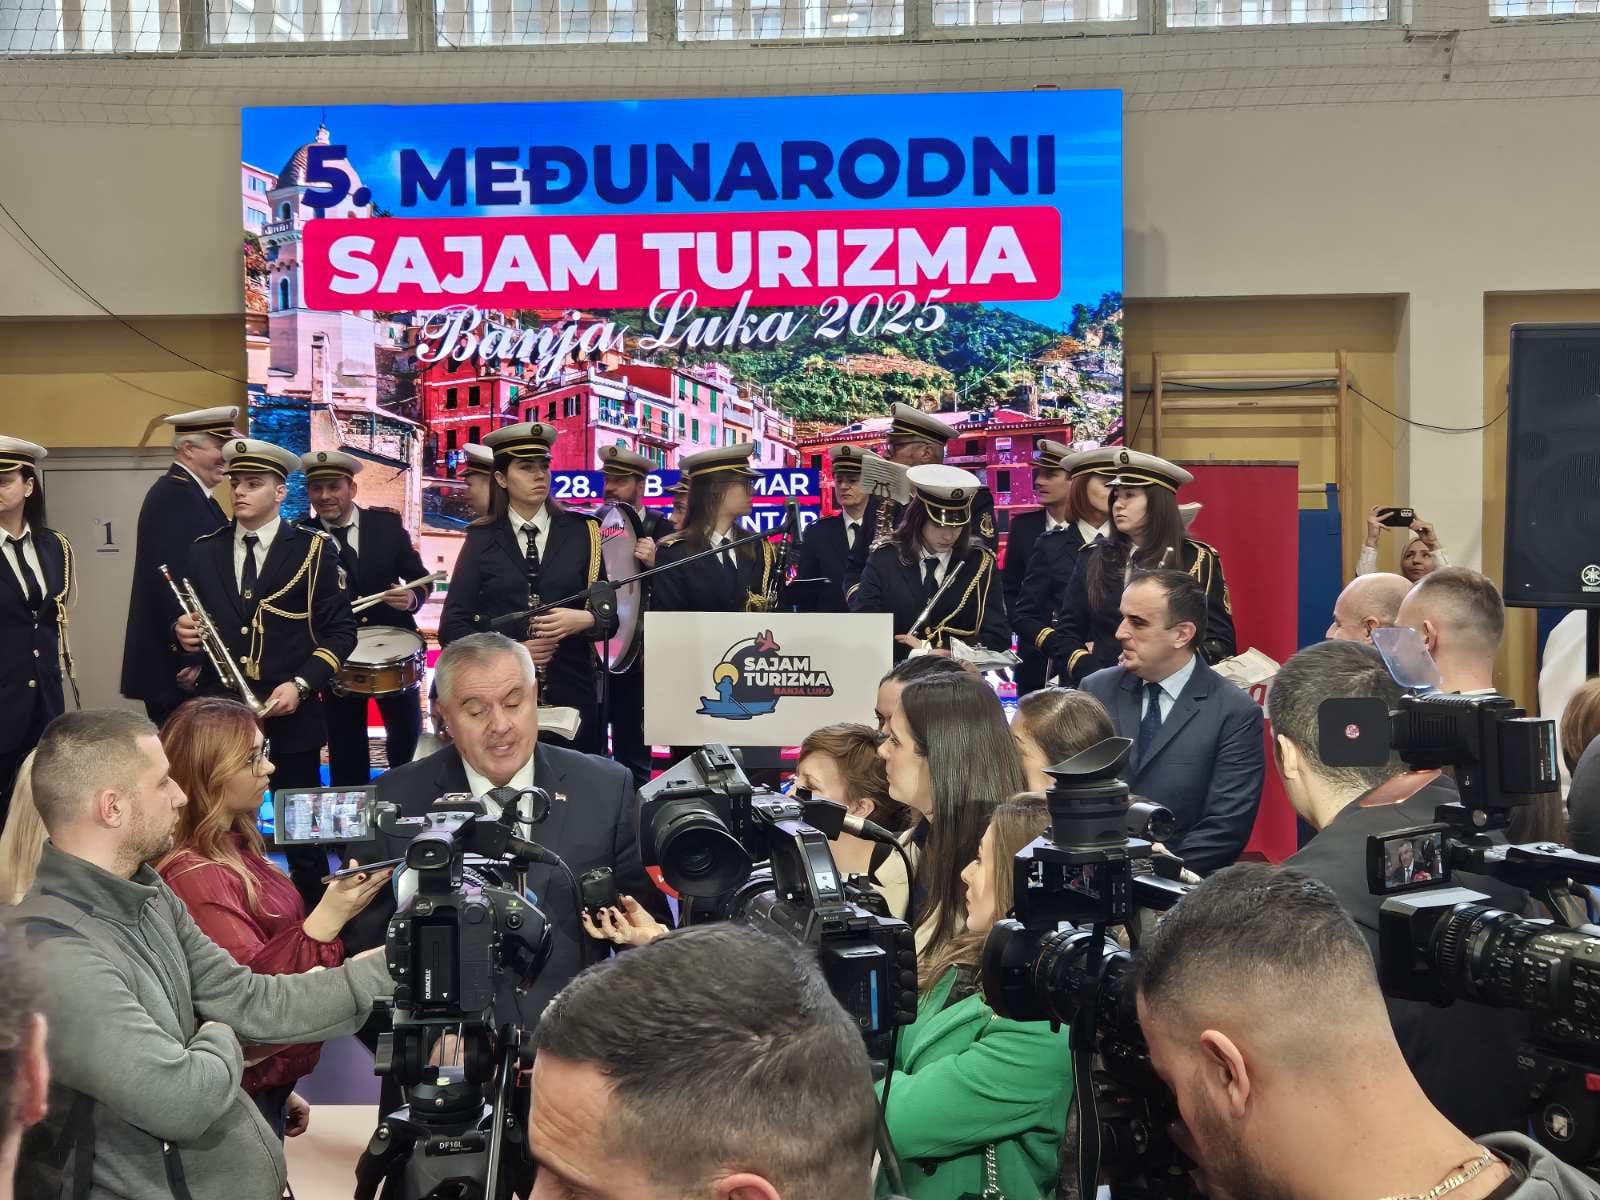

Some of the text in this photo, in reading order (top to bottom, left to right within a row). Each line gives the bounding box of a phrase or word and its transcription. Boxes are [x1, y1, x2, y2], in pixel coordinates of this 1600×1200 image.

[301, 134, 1056, 209] 5. MEĐUNARODNI
[328, 225, 1037, 295] SAJAM TURIZMA
[415, 288, 951, 384] Banja Luka 2025
[554, 475, 598, 498] 28.
[103, 521, 114, 545] 1
[744, 656, 809, 671] SAJAM
[744, 672, 830, 687] TURIZMA
[774, 687, 832, 696] BANJA LUKA
